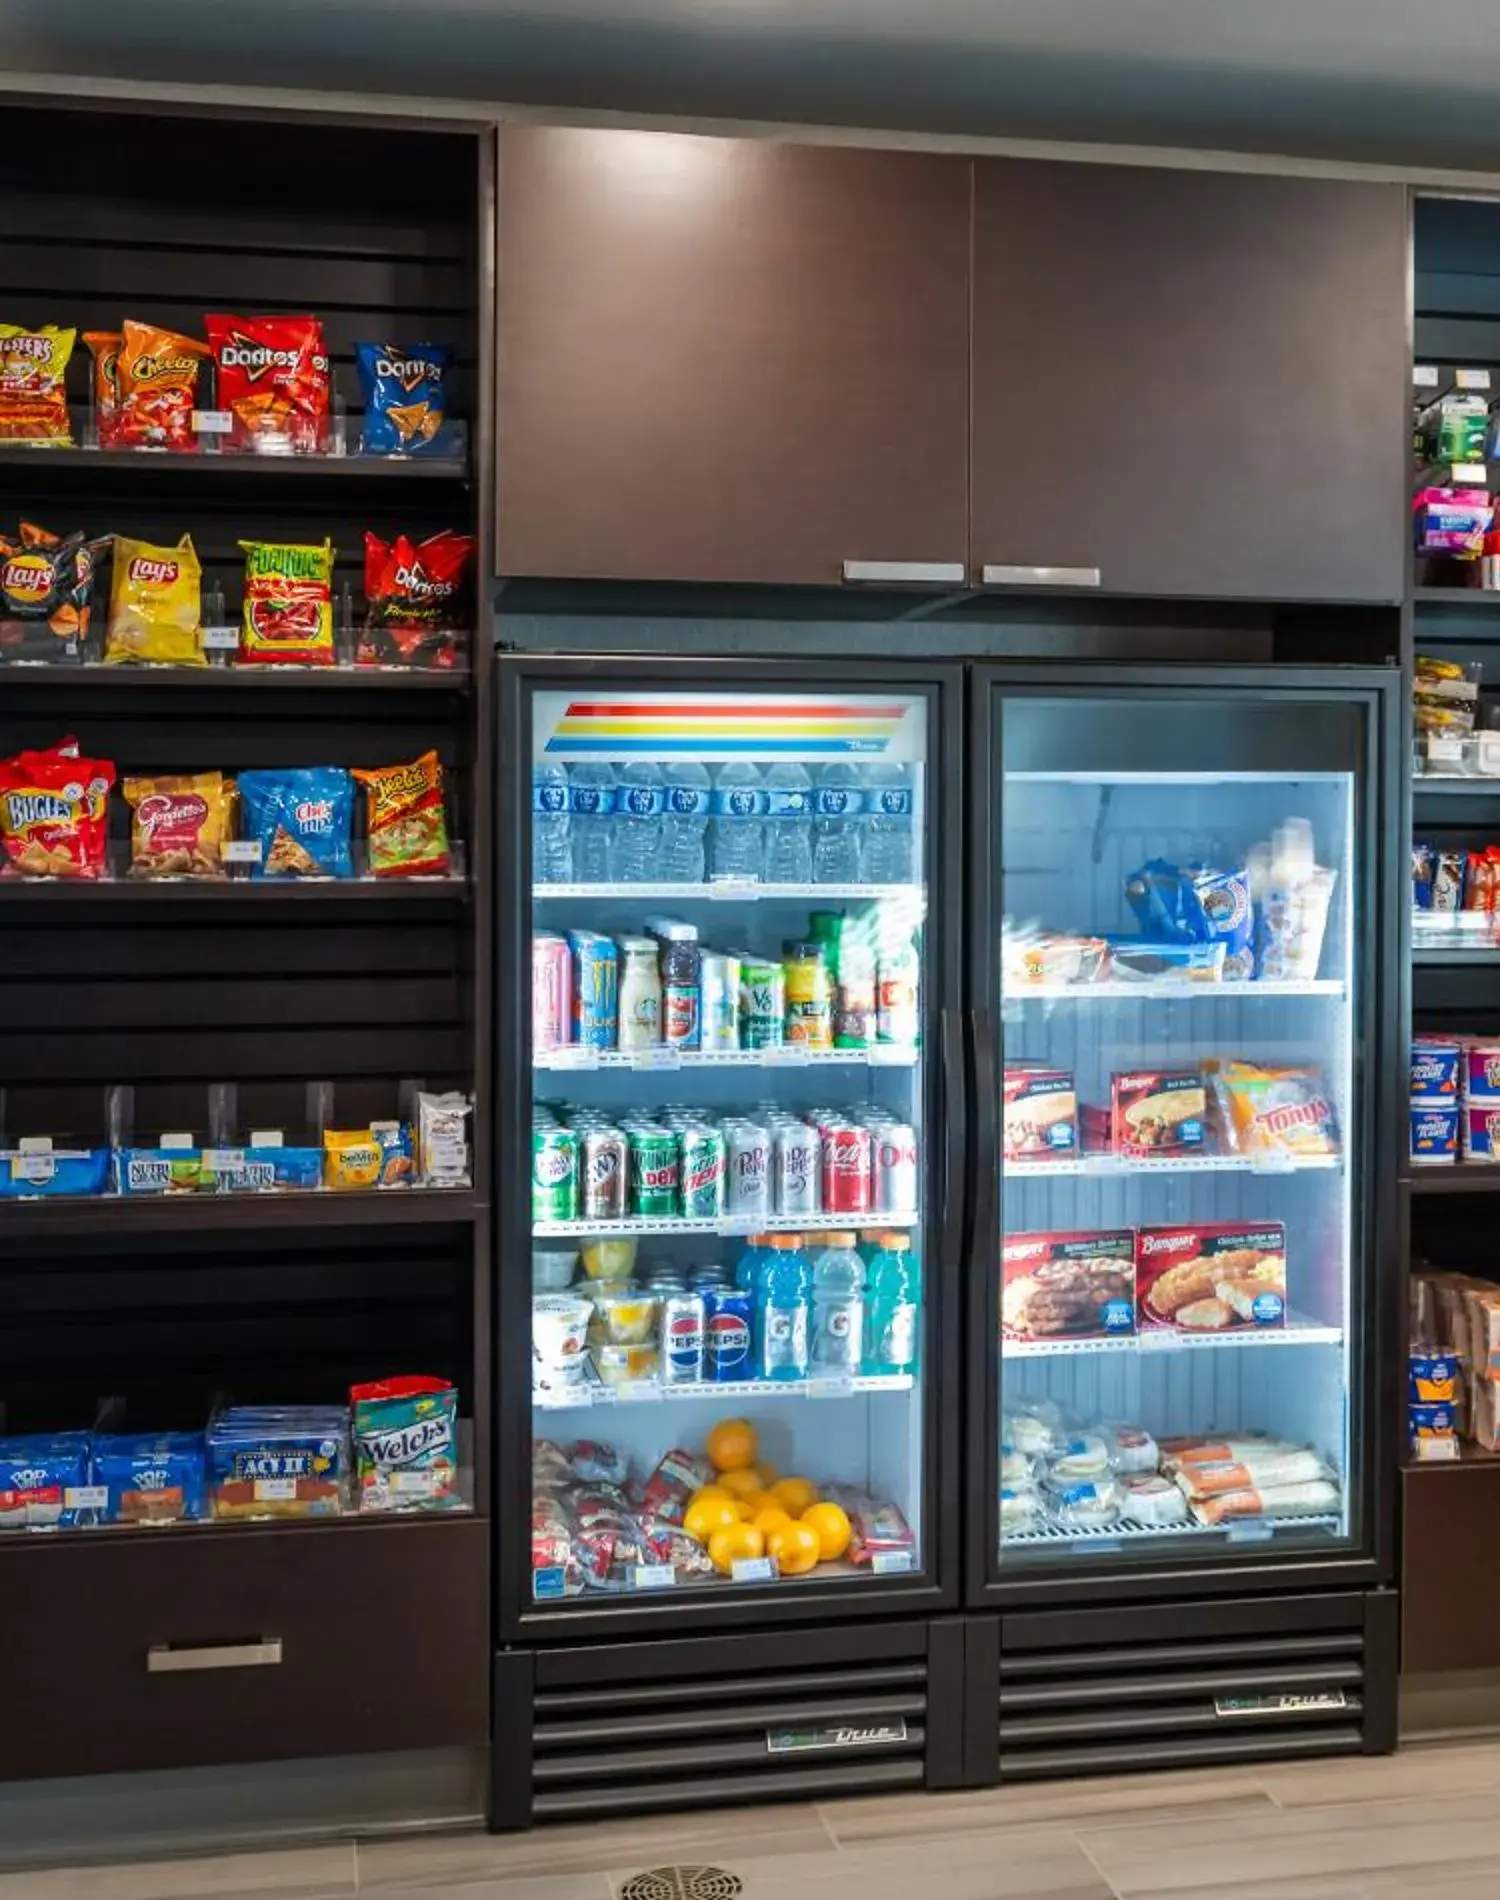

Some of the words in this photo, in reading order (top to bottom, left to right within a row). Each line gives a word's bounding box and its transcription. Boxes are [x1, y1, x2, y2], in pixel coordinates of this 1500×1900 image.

[221, 347, 299, 368] Doritos
[376, 359, 441, 381] Doritos
[5, 565, 55, 592] Lay's
[132, 559, 179, 584] Lay's
[1257, 1098, 1329, 1134] Tony's
[363, 1420, 447, 1463] Welch's
